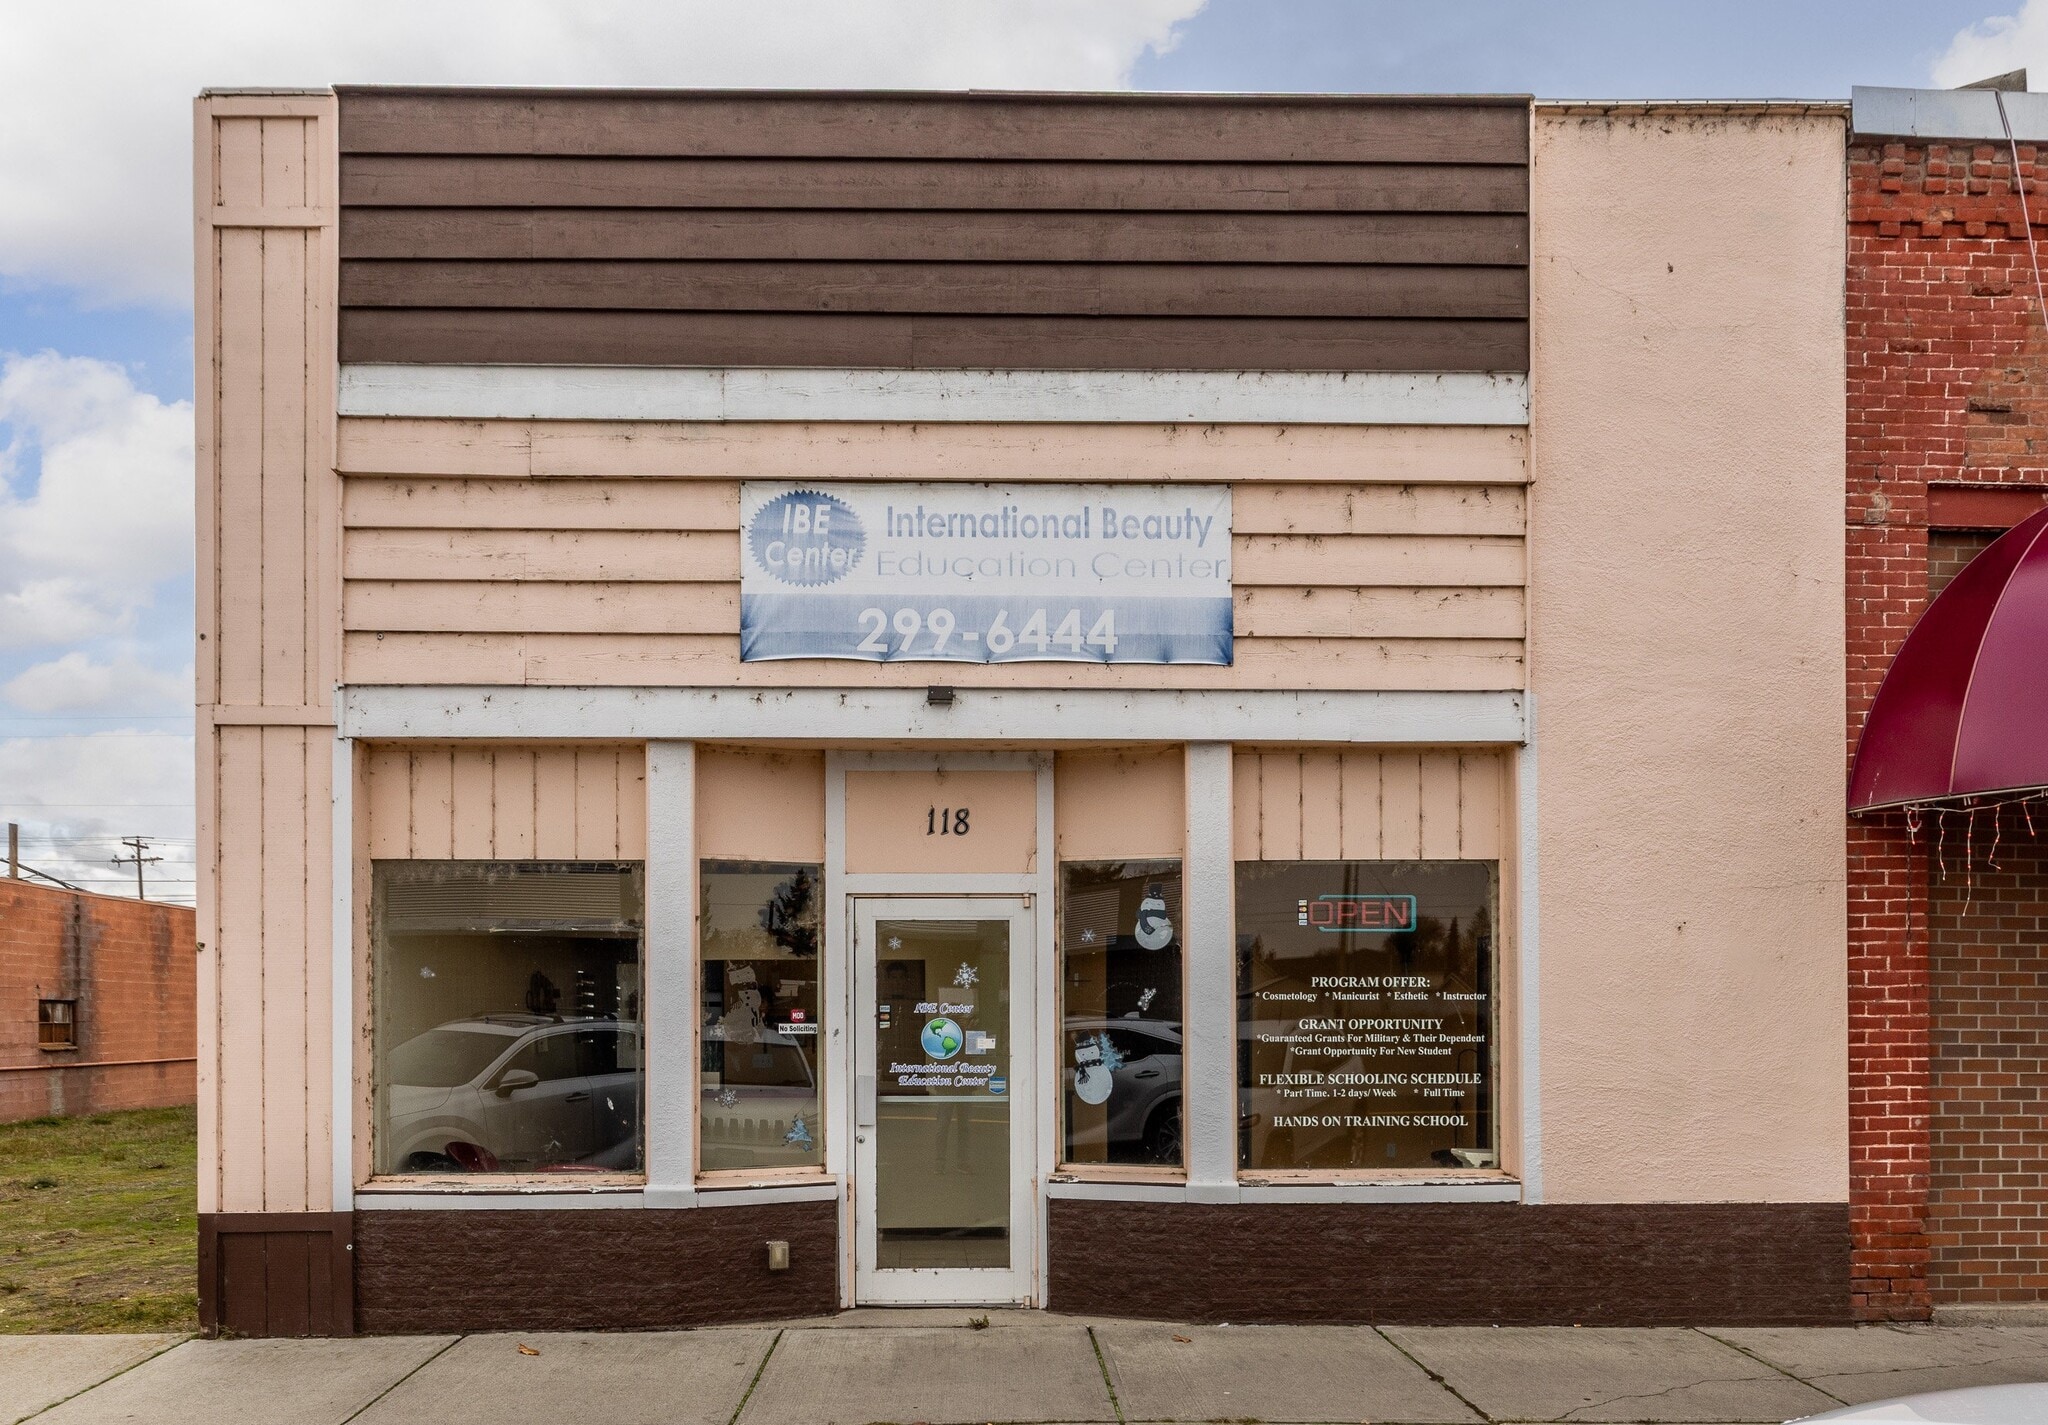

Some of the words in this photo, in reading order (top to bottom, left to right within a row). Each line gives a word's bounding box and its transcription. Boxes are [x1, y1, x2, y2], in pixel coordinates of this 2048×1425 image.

[782, 503, 831, 535] IBE
[887, 505, 1090, 539] International
[1102, 507, 1213, 548] Beauty
[765, 541, 857, 568] Center
[877, 550, 1075, 578] Education
[1092, 552, 1226, 579] Center
[857, 607, 1118, 654] 299-6444
[927, 807, 970, 836] 118
[1309, 901, 1408, 925] OPEN
[1311, 976, 1380, 988] PROGRAM
[1382, 976, 1430, 988] OFFER:
[1262, 991, 1318, 1002] Cosmetology
[1332, 991, 1380, 1001] Manicurist
[1394, 991, 1429, 1001] Esthetic
[1443, 991, 1487, 1001] Instructor
[940, 1003, 974, 1014] Center
[790, 1025, 817, 1033] Soliciting
[1298, 1018, 1346, 1030] GRANT
[1348, 1018, 1443, 1030] OPPORTUNITY
[1314, 1033, 1345, 1043] Grants
[1347, 1033, 1363, 1043] For
[1365, 1033, 1401, 1045] Military
[1402, 1033, 1411, 1043] &
[1413, 1033, 1437, 1043] Their
[1439, 1033, 1486, 1045] Dependent
[1323, 1046, 1377, 1058] Opportunity
[1379, 1046, 1395, 1056] For
[1396, 1046, 1416, 1056] New
[1417, 1046, 1452, 1056] Student
[889, 1061, 960, 1074] International
[959, 1062, 997, 1077] Beauty
[898, 1074, 952, 1087] Education
[954, 1075, 990, 1088] Center
[1259, 1073, 1325, 1085] FLEXIBLE
[1327, 1073, 1408, 1085] SCHOOLING
[1410, 1073, 1482, 1085] SCHEDULE
[1283, 1088, 1303, 1098] Part
[1332, 1088, 1347, 1097] 1-2
[1372, 1088, 1397, 1097] Week
[1423, 1088, 1441, 1097] Full
[1442, 1088, 1466, 1097] Time
[1273, 1116, 1319, 1127] HANDS
[1321, 1116, 1342, 1127] ON
[1343, 1115, 1410, 1127] TRAINING
[1412, 1115, 1469, 1127] SCHOOL
